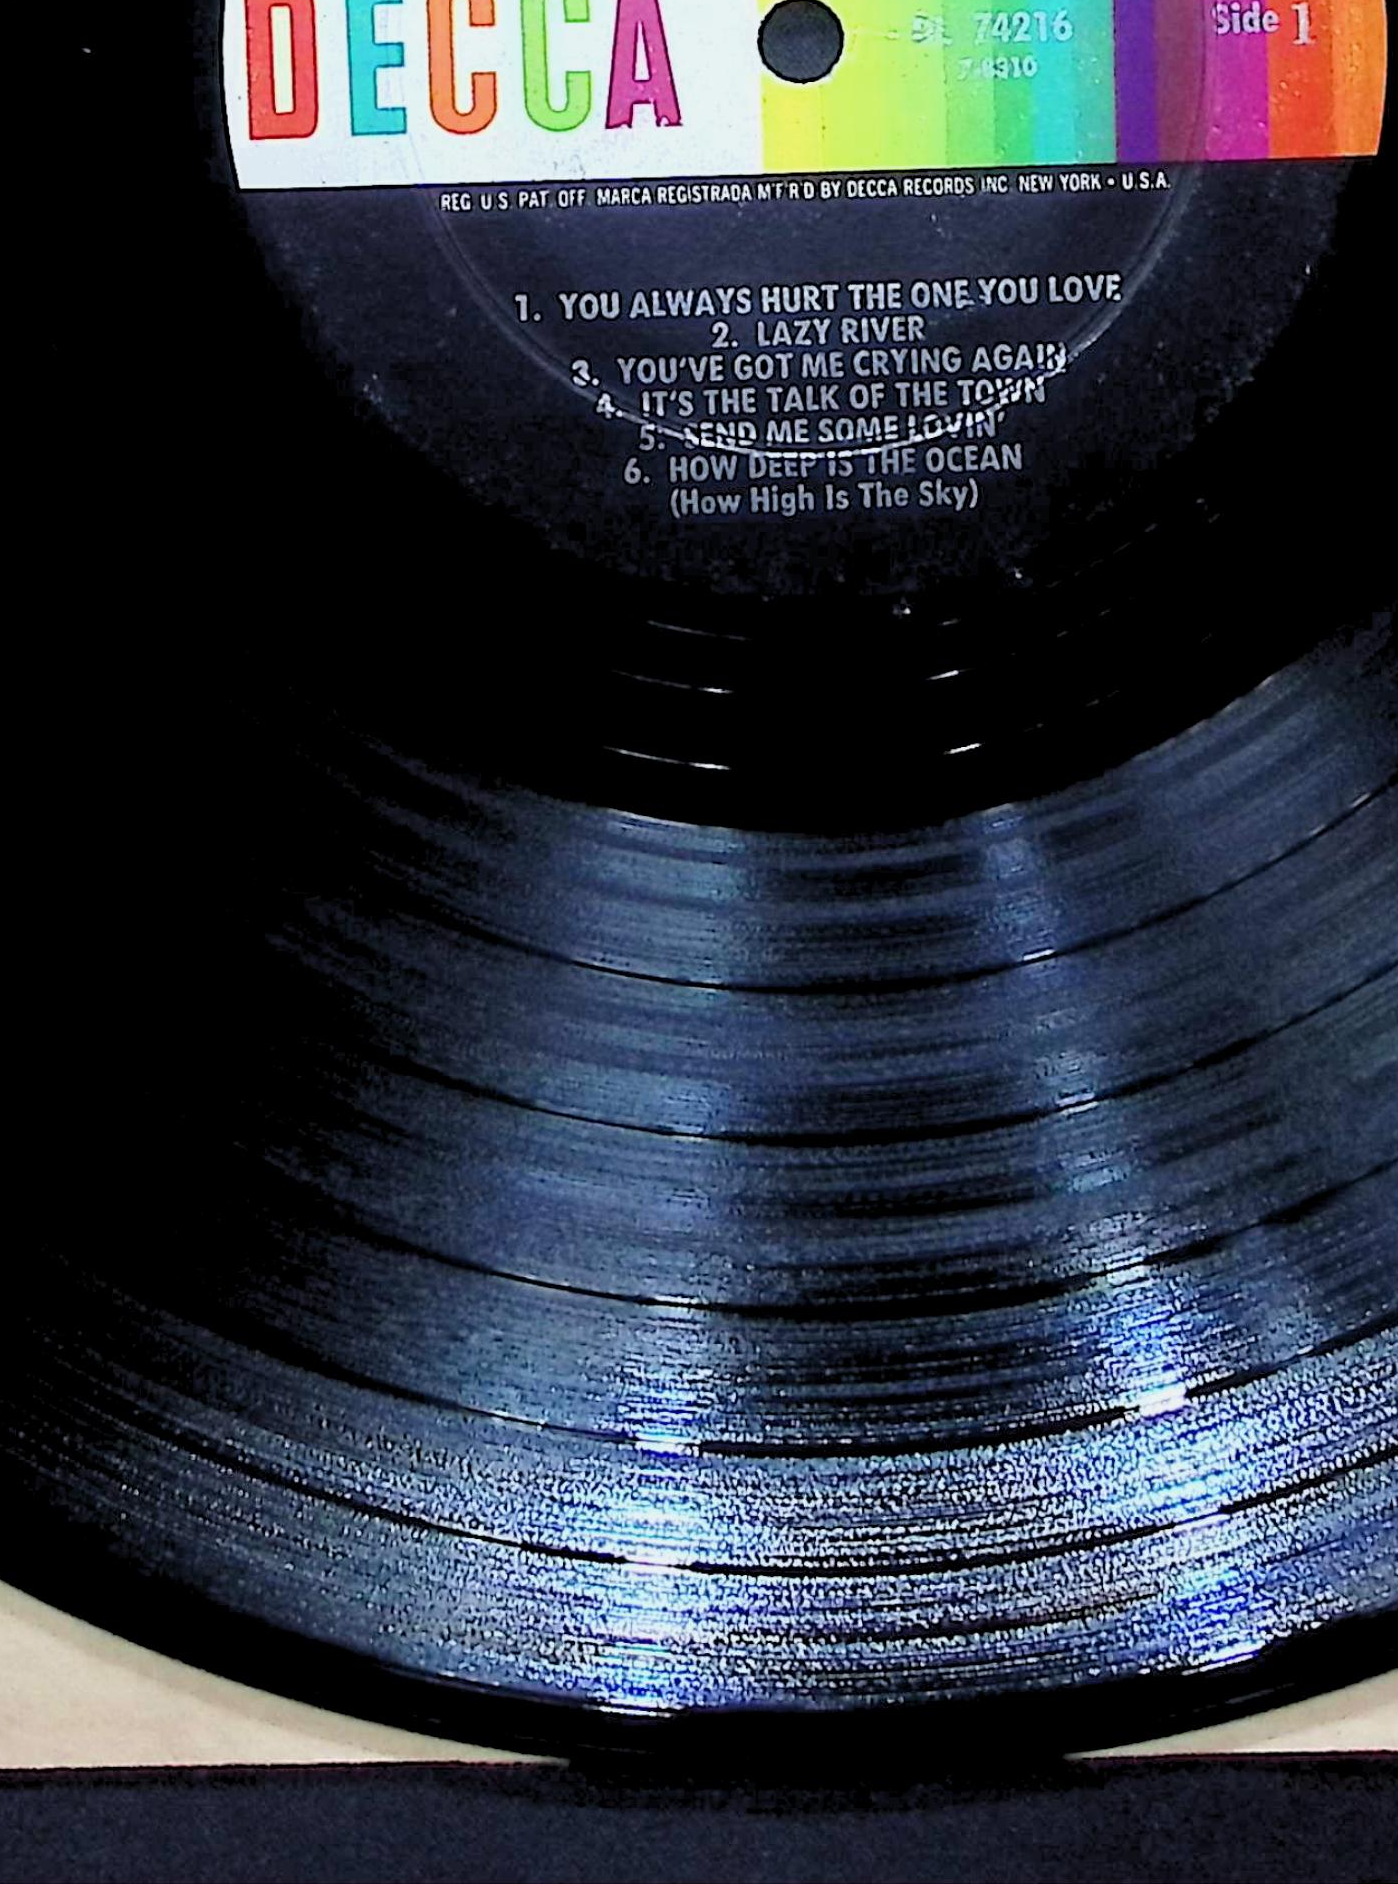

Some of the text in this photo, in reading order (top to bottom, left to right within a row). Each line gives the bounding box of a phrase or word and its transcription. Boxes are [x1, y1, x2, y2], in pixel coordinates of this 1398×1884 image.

[975, 10, 1073, 45] 74216
[1211, 0, 1316, 46] Side 1
[596, 186, 651, 206] MARCA
[657, 183, 752, 204] REGISTRADA
[820, 180, 842, 199] BY
[846, 178, 898, 198] DECCA
[903, 176, 974, 197] RECORDS
[1018, 174, 1053, 193] NEW
[1059, 173, 1102, 192] YORK
[515, 274, 1122, 322] 1. YOU ALWAYS HURT THE ONE YOU LOVE
[711, 315, 926, 348] 2. LAZY RIVER
[571, 343, 1067, 387] 3. YOU'VE GOT ME CRYING AGAIN
[642, 390, 695, 417] IT'S
[703, 387, 757, 416] THE
[766, 385, 841, 414] TALK
[850, 382, 886, 410] OF
[894, 379, 949, 408] THE
[957, 377, 1047, 406] TOWN
[684, 420, 758, 450] SEND
[766, 418, 811, 447] ME
[818, 415, 900, 444] SOME
[623, 442, 1023, 485] 6. HOW DEEP IS THE OCEAN
[670, 477, 979, 519] (How High Is The Sky)
